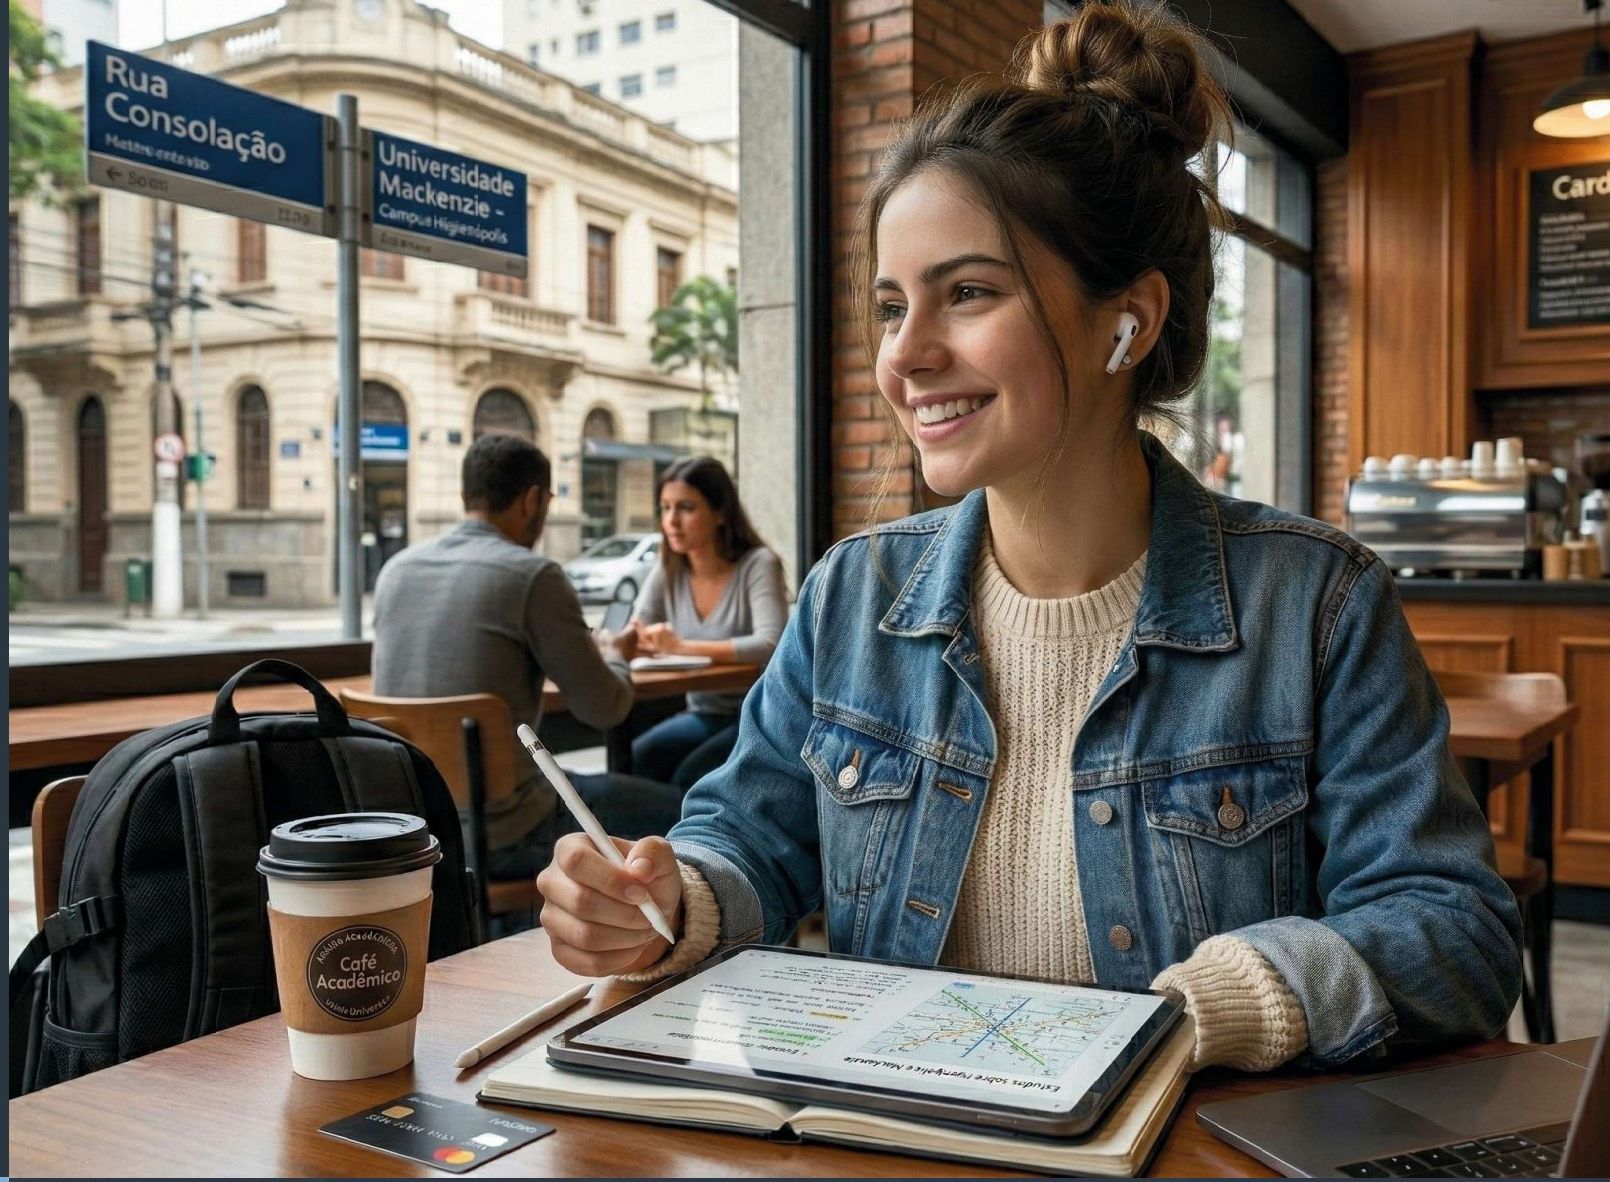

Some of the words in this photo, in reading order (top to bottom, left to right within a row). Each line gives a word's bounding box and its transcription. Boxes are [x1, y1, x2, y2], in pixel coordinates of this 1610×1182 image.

[105, 54, 168, 99] Rua
[105, 92, 286, 165] Consolação
[379, 140, 515, 198] Universidade
[379, 170, 491, 219] Mackenzie
[378, 203, 433, 228] Campus
[433, 215, 508, 245] Higienópolis
[316, 969, 401, 990] Acadêmico
[340, 953, 377, 972] Café
[975, 1073, 1010, 1087] sobre
